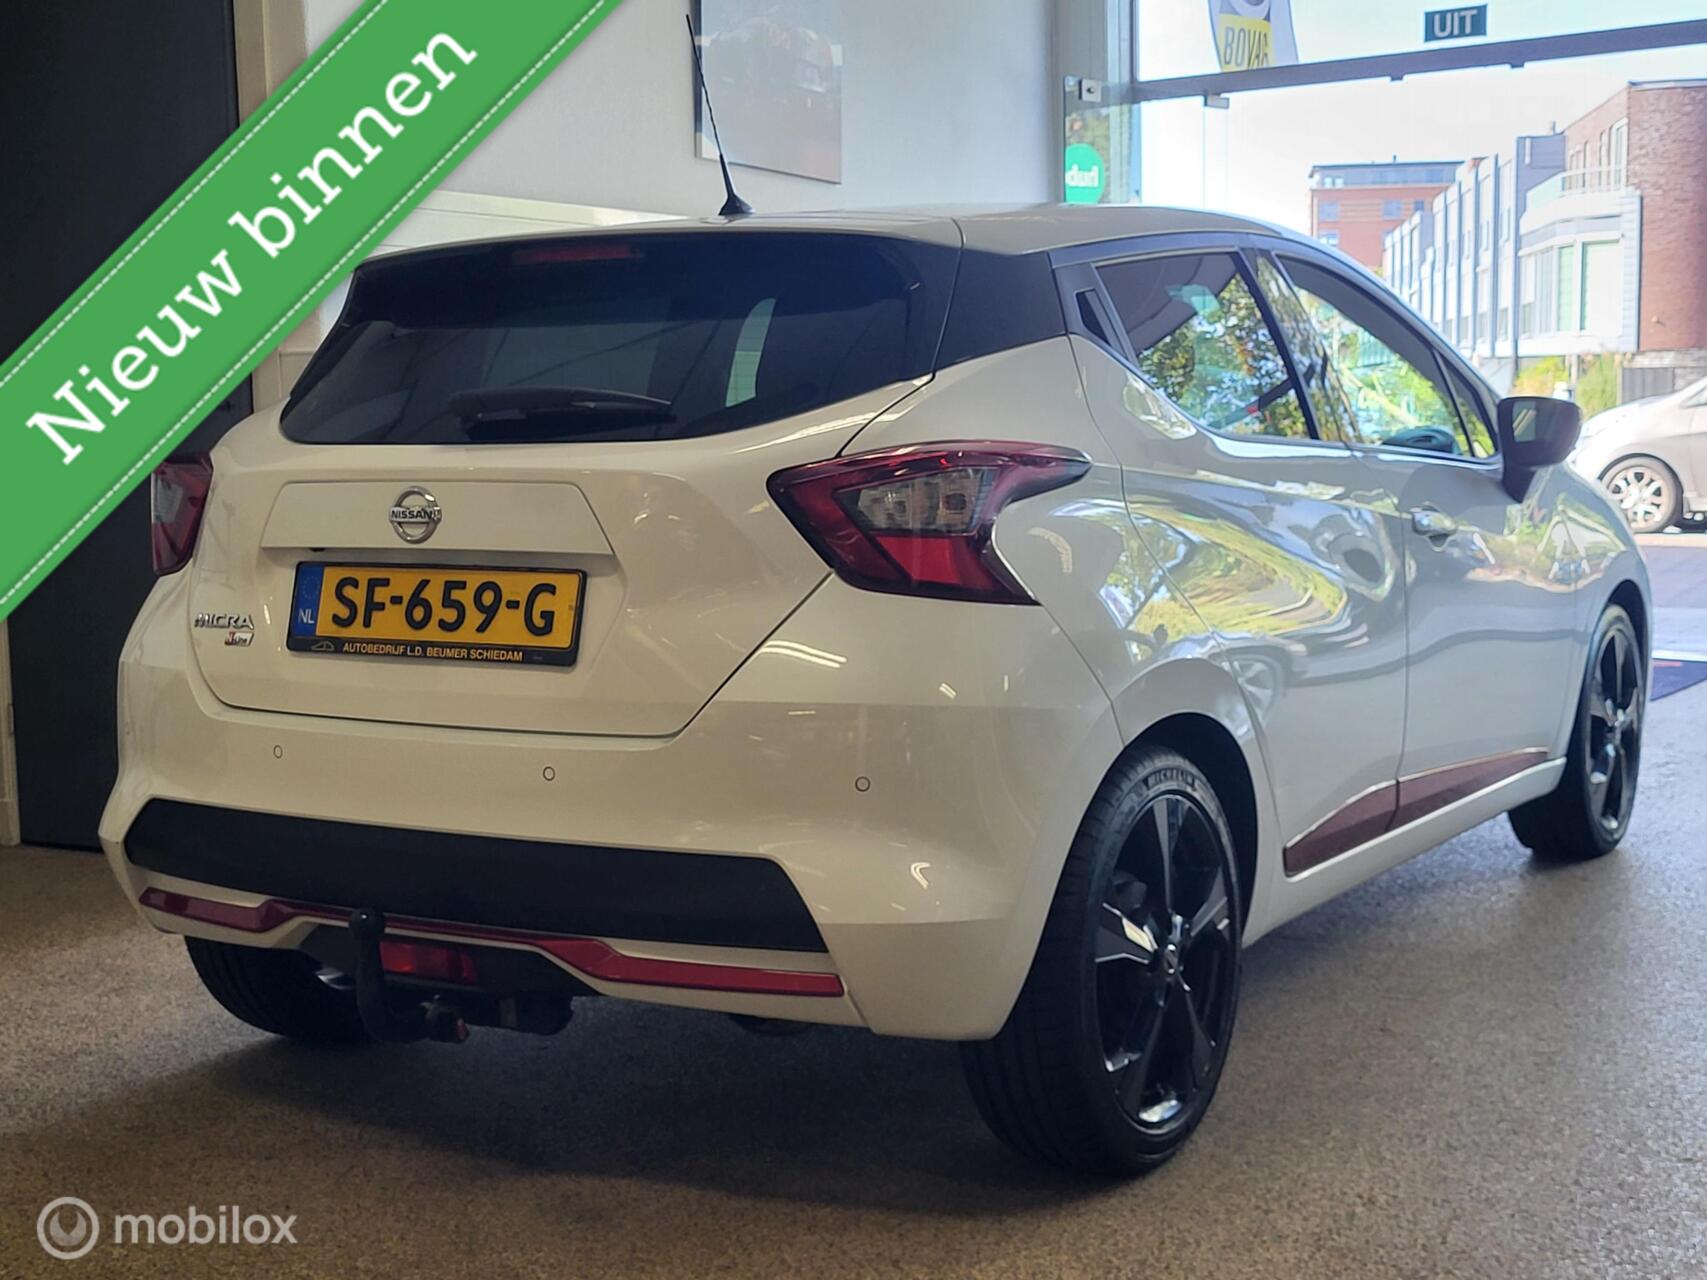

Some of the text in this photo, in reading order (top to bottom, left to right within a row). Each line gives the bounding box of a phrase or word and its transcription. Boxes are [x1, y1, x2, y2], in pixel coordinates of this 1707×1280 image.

[1433, 9, 1478, 37] UIT
[391, 510, 433, 520] NISSAN
[332, 576, 558, 637] SF-659-G
[194, 613, 254, 630] MICRA
[298, 608, 315, 624] NL
[342, 642, 524, 662] AUTOBEDRIJF L.D. BEUMER SCHIEDAM
